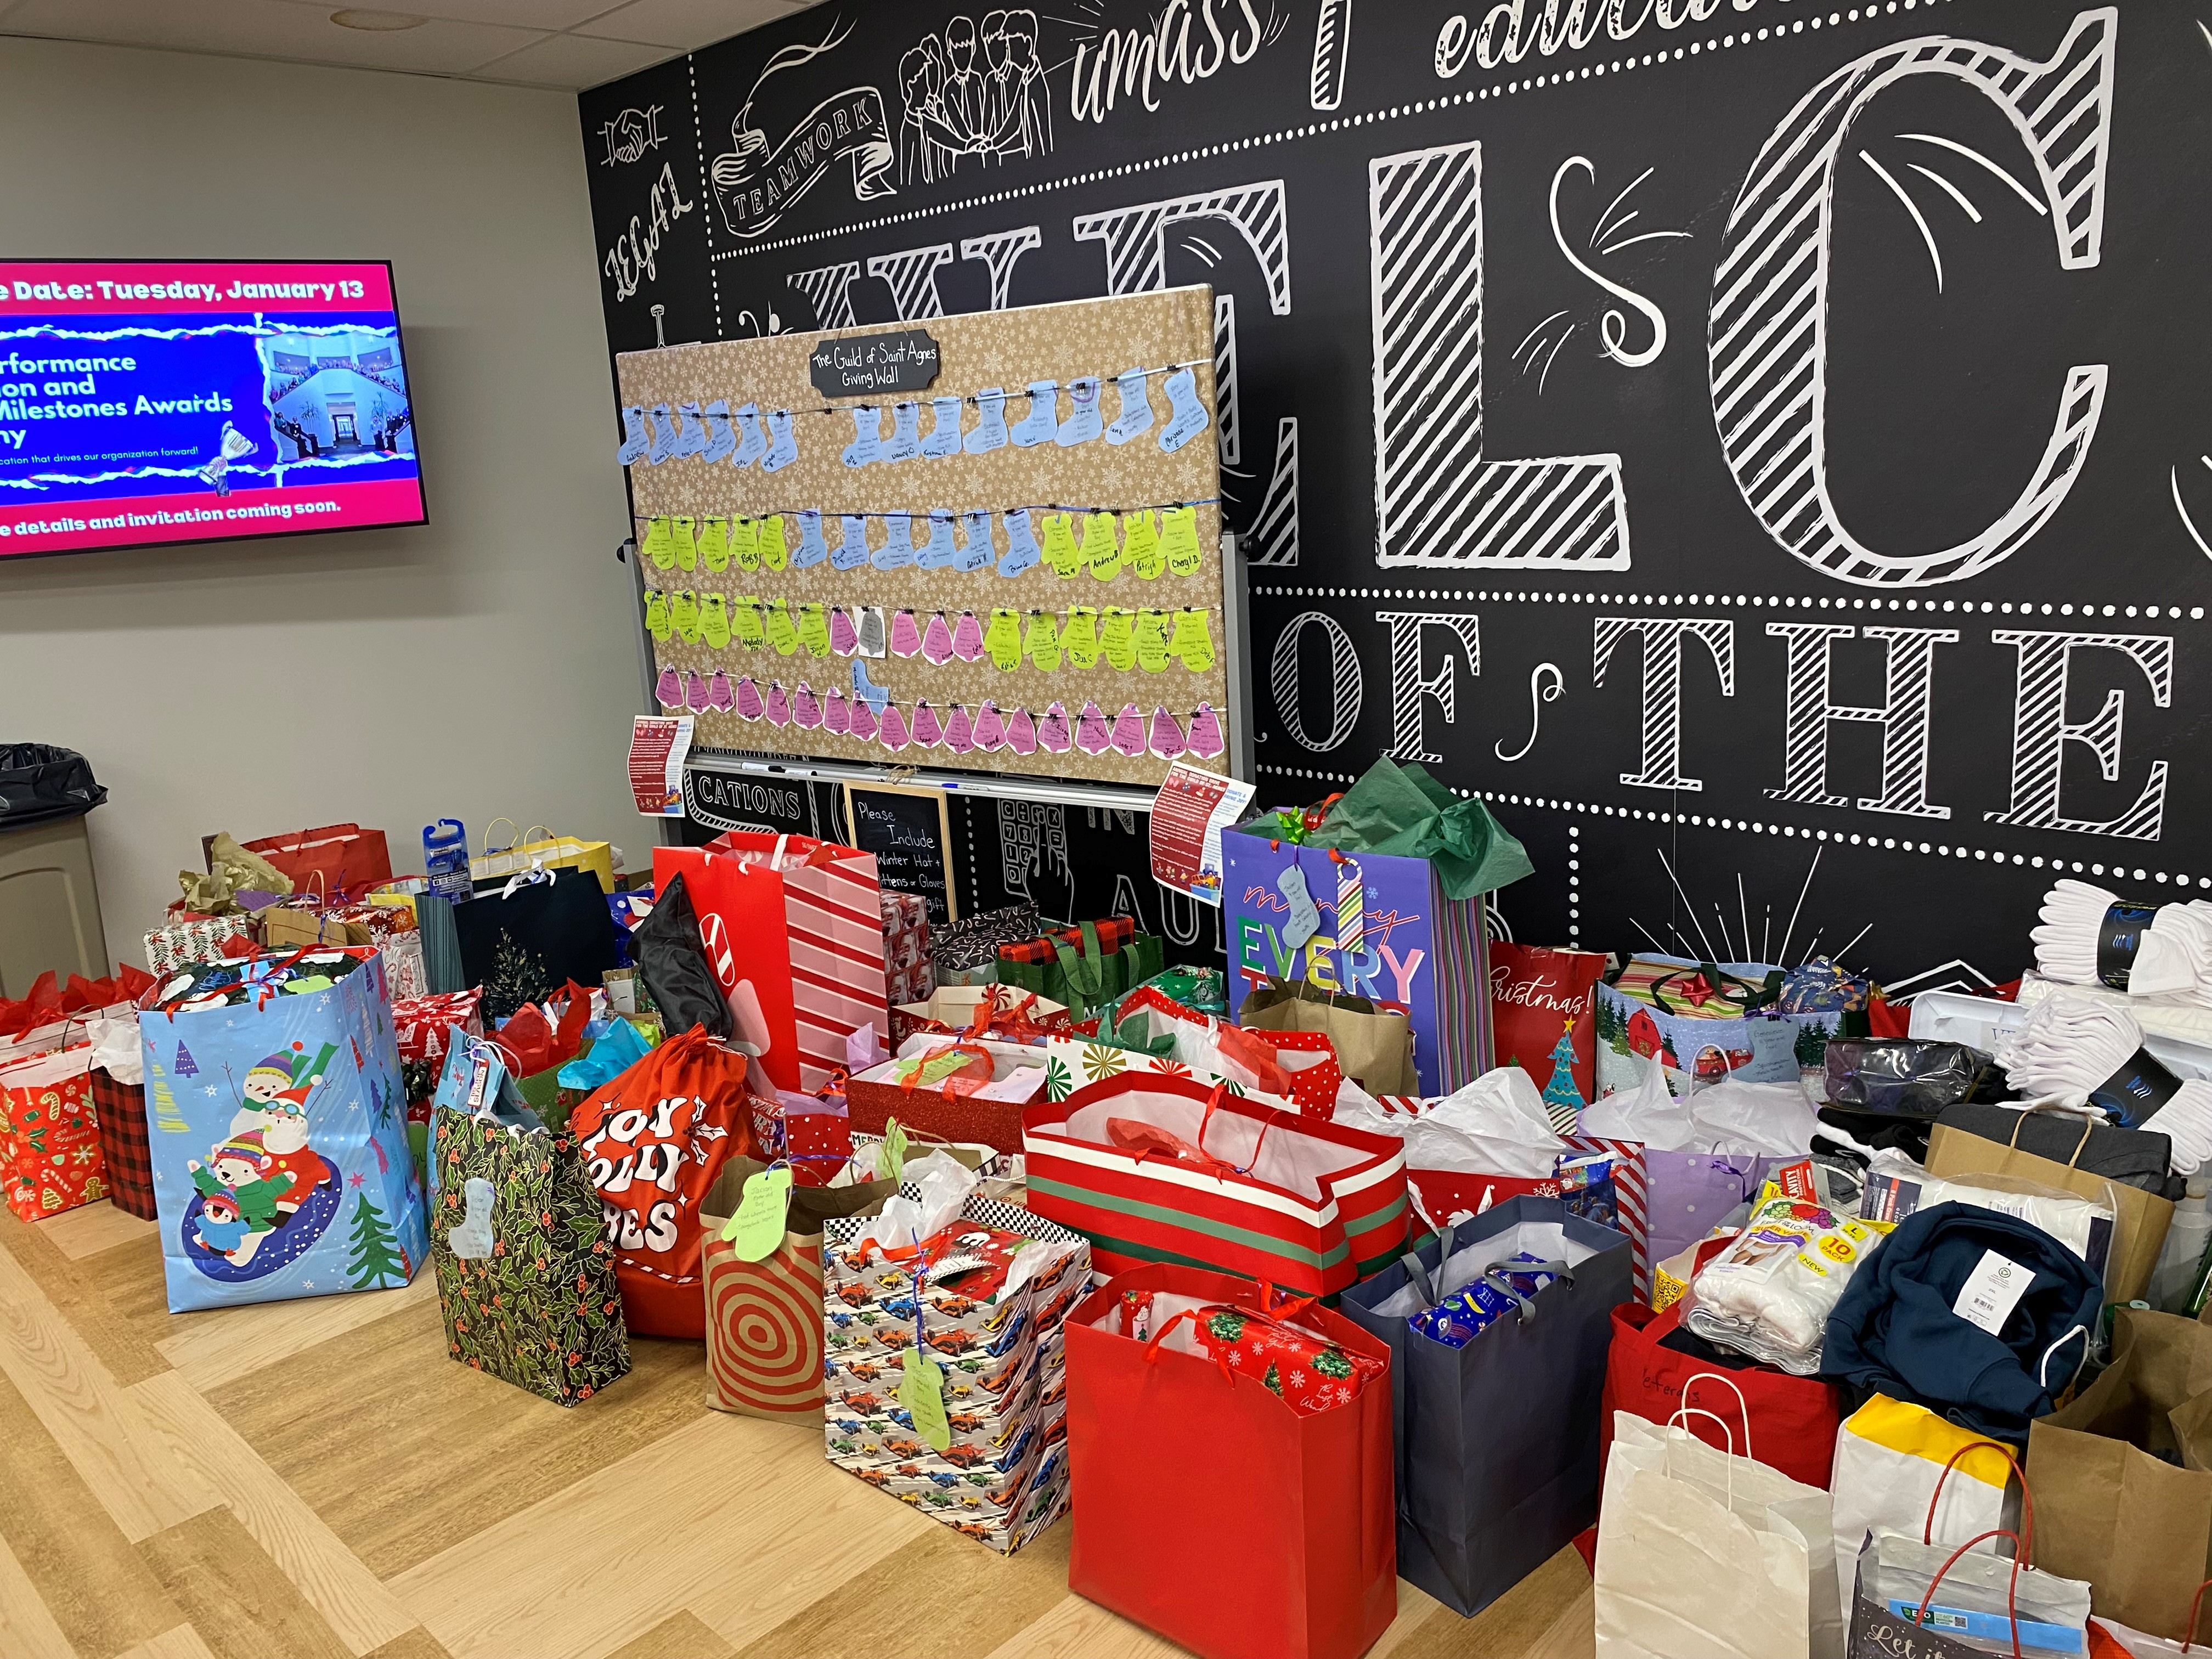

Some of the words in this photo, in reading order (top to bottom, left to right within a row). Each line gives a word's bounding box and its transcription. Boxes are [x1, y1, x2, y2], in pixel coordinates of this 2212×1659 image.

[733, 97, 872, 220] TEAMWORK
[14, 281, 93, 300] Date:
[98, 280, 222, 301] Tuesday,
[227, 280, 335, 301] January
[338, 280, 364, 297] 13
[813, 353, 832, 369] The
[834, 347, 862, 369] Guild
[866, 348, 876, 363] of
[879, 341, 906, 364] Saint
[907, 337, 937, 366] Agnes
[43, 376, 95, 395] and
[842, 373, 873, 388] Giving
[876, 366, 899, 385] Wall
[134, 392, 233, 415] Awards
[31, 455, 50, 464] that
[53, 453, 81, 462] drives
[101, 449, 159, 462] organization
[160, 447, 199, 459] forward!
[14, 516, 86, 537] details
[89, 515, 125, 529] and
[128, 509, 224, 528] invitation
[227, 503, 292, 520] coming
[295, 500, 341, 514] soon.
[1270, 610, 1481, 764] OF
[1591, 616, 2175, 841] THE
[698, 775, 801, 820] CATIONS
[857, 802, 896, 822] Please
[886, 825, 935, 848] Include
[875, 851, 909, 866] Winter
[913, 854, 933, 867] Hat
[878, 873, 909, 888] ittens
[918, 873, 946, 889] Gloves
[926, 897, 945, 913] gift
[1237, 915, 1425, 1005] EVERY
[588, 1142, 690, 1193] OLLY
[1785, 1169, 1799, 1200] CAVITY
[1820, 1245, 1845, 1262] PACK
[1829, 1237, 1852, 1256] 10
[1802, 1257, 1825, 1274] NEW
[1642, 1368, 1700, 1402] eterans
[1911, 1609, 1931, 1619] EO
[1867, 1624, 1916, 1659] Let
